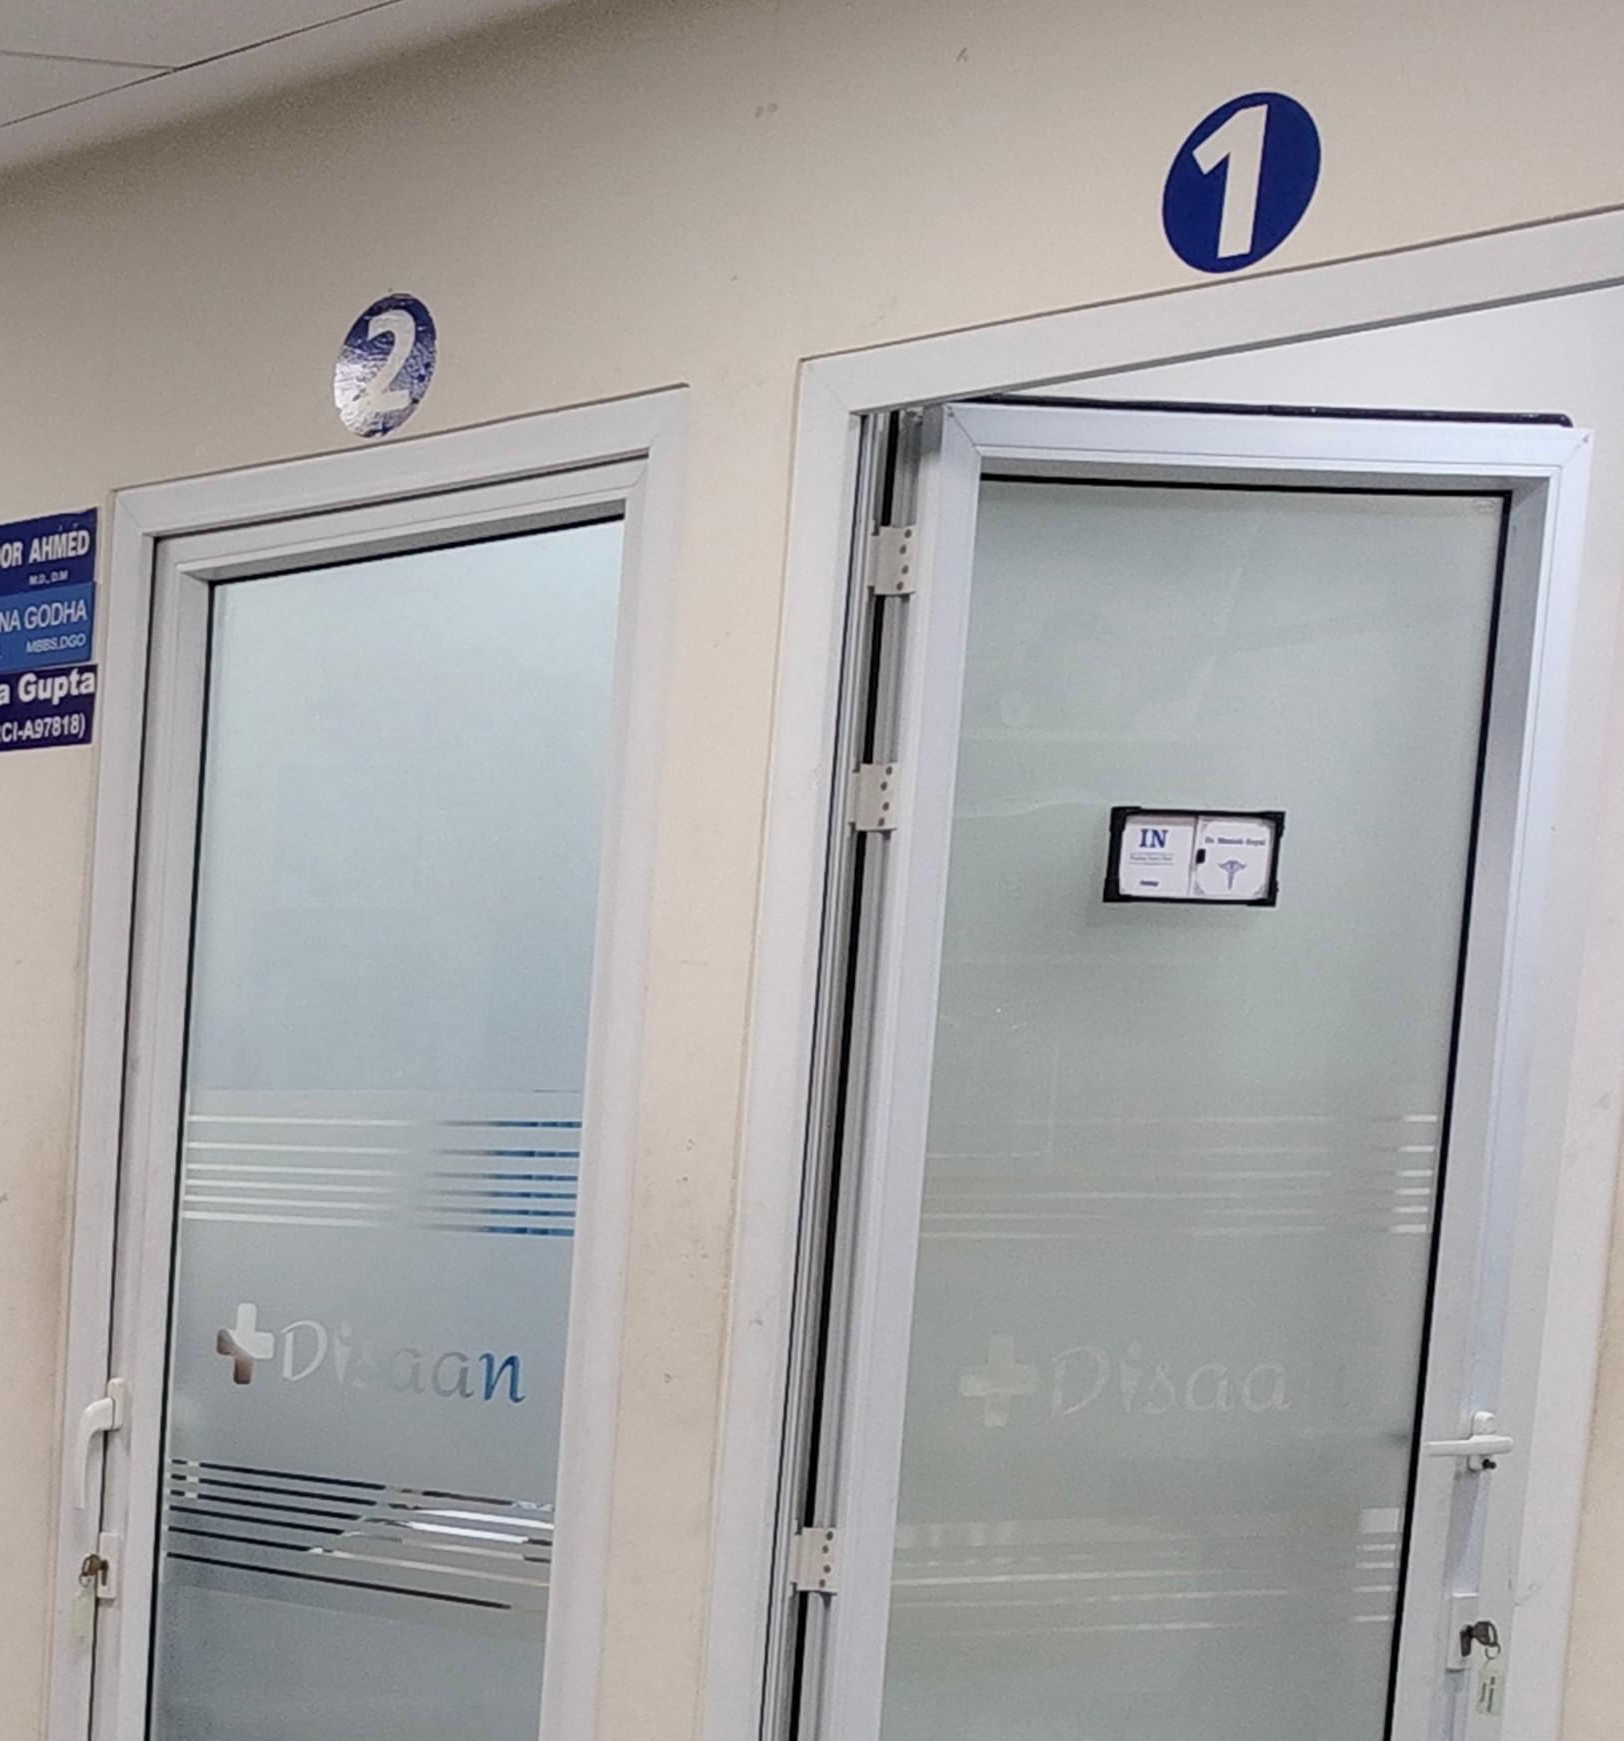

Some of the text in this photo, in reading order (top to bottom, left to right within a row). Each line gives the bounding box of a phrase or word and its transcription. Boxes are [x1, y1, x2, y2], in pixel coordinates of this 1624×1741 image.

[1192, 104, 1268, 259] 1
[356, 308, 416, 413] 2
[28, 530, 91, 565] AHMED
[24, 599, 88, 629] GODHA
[18, 668, 96, 705] Gupta
[1139, 829, 1169, 848] IN
